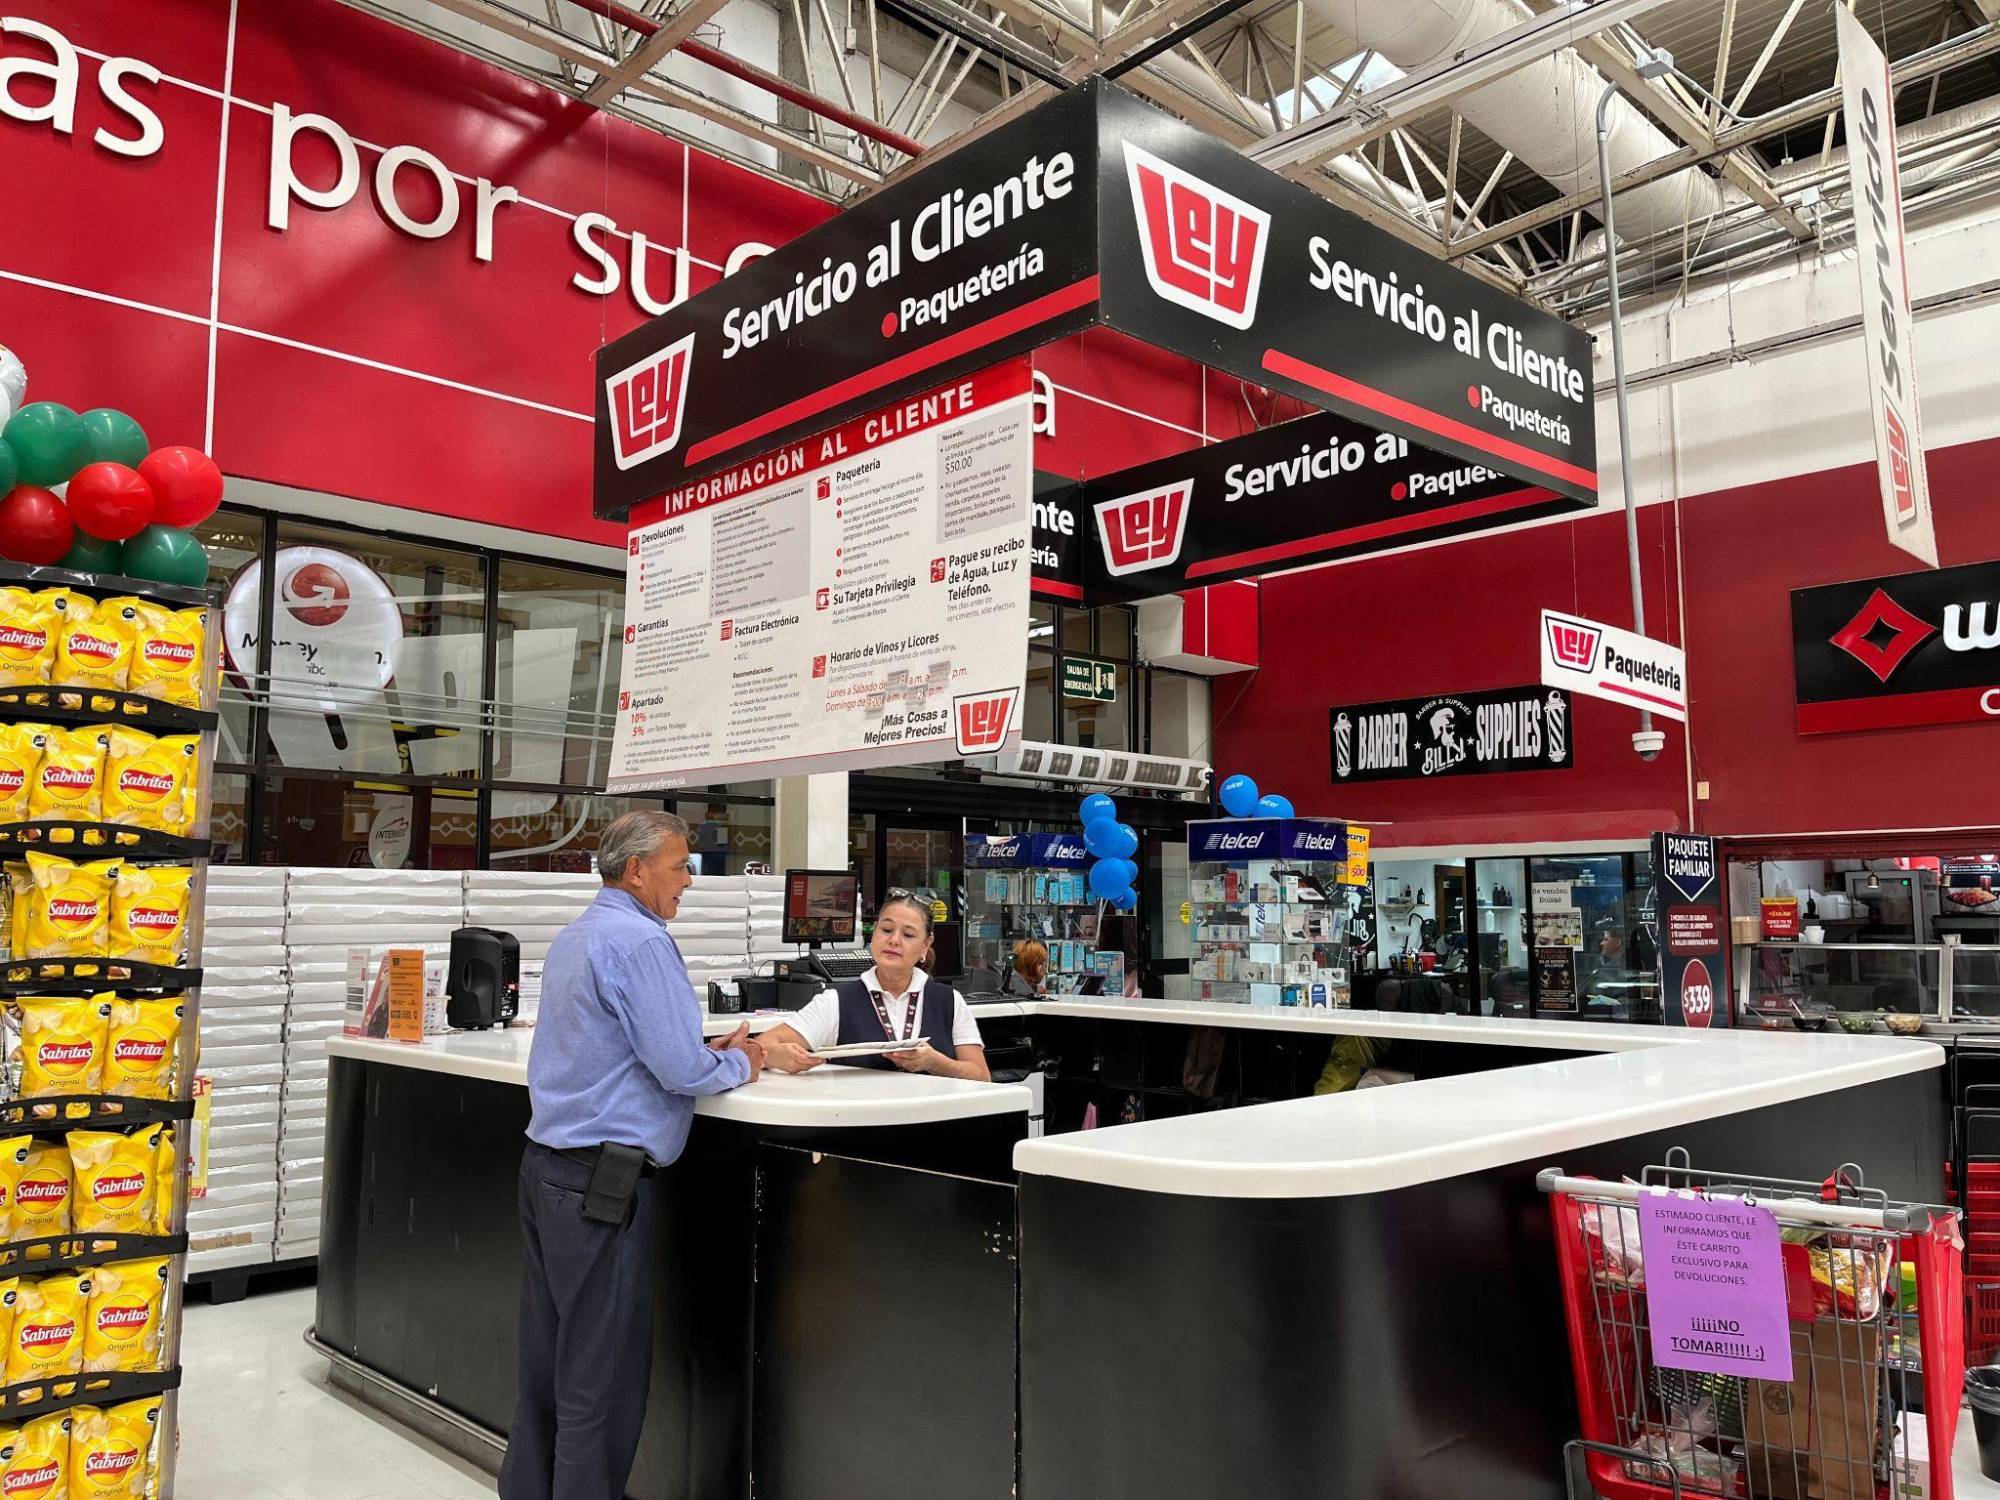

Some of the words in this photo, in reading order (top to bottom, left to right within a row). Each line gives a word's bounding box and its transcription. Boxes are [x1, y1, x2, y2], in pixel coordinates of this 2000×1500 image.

[268, 102, 518, 262] por
[573, 212, 690, 316] su
[722, 256, 857, 360] Servicio
[865, 219, 901, 288] al
[910, 150, 1075, 262] Cliente
[899, 240, 1045, 334] Paquetería
[1308, 235, 1446, 343] Servicio
[1453, 308, 1481, 359] al
[1486, 322, 1584, 403] Cliente
[1480, 385, 1571, 446] Paquetería
[664, 446, 805, 515] INFORMACIÓN
[820, 432, 848, 461] AL
[864, 381, 974, 443] CLIENTE
[836, 457, 881, 483] Paquetería
[1224, 436, 1365, 502] Servicio
[641, 523, 684, 544] Devoluciones
[949, 551, 979, 568] Pague
[980, 547, 991, 560] su
[993, 537, 1025, 556] recibo
[948, 571, 961, 585] de
[962, 566, 990, 583] Agua,
[992, 560, 1010, 574] Luz
[1011, 558, 1018, 573] y
[833, 593, 844, 606] Su
[845, 586, 874, 603] Tarjeta
[875, 574, 917, 596] Privilegia
[948, 583, 992, 602] Teléfono.
[734, 624, 760, 637] Factura
[760, 613, 800, 632] Electrónica
[67, 634, 121, 658] Sabritas
[144, 641, 195, 660] Sabritas
[830, 648, 861, 664] Horario
[862, 644, 874, 657] de
[875, 641, 900, 655] Vinos
[900, 640, 906, 650] y
[907, 632, 940, 649] Licores
[3, 661, 34, 673] Original
[77, 669, 109, 681] Original
[1066, 665, 1082, 676] SALIDA
[1083, 667, 1090, 677] DE
[155, 673, 185, 683] Original
[1063, 679, 1093, 691] EMERGENCIA
[631, 693, 664, 711] Apartado
[631, 711, 648, 724] 10%
[907, 710, 939, 724] Cosas
[941, 709, 949, 719] a
[632, 726, 645, 738] 5%
[863, 729, 903, 746] Mejores
[904, 721, 947, 739] Precios!
[1358, 712, 1408, 770] BARBER
[1475, 699, 1542, 762] SUPPLIES
[42, 767, 95, 784] Sabritas
[119, 773, 173, 791] Sabritas
[52, 802, 84, 812] Original
[127, 804, 158, 815] Original
[987, 842, 1020, 857] telcel
[1219, 831, 1265, 850] telcel
[1305, 833, 1337, 851] telcel
[1667, 836, 1709, 859] PAQUETE
[1055, 844, 1088, 860] telcel
[1668, 859, 1711, 878] FAMILIAR
[48, 902, 98, 916] Sabritas
[128, 909, 179, 927] Sabritas
[138, 942, 168, 951] Original
[1683, 984, 1711, 1014] $339
[38, 1045, 94, 1062] Sabritas
[49, 1078, 81, 1088] Original
[123, 1074, 154, 1084] Original
[16, 1182, 68, 1198] Sabritas
[93, 1177, 145, 1197] Sabritas
[24, 1216, 54, 1226] Original
[104, 1210, 135, 1221] Original
[1655, 1208, 1703, 1222] ESTIMADO
[1704, 1213, 1746, 1227] CLIENTE,
[1746, 1216, 1757, 1226] LE
[1663, 1225, 1729, 1239] INFORMAMOS
[1730, 1230, 1752, 1241] QUE
[1699, 1243, 1741, 1255] CARRITO
[1671, 1255, 1722, 1269] EXCLUSIVO
[1723, 1260, 1749, 1271] PARA
[97, 1308, 150, 1326] Sabritas
[20, 1326, 75, 1344] Sabritas
[107, 1341, 138, 1352] Original
[31, 1359, 64, 1371] Original
[85, 1453, 138, 1470] Sabritas
[3, 1467, 59, 1489] Sabritas
[94, 1486, 125, 1498] Original
